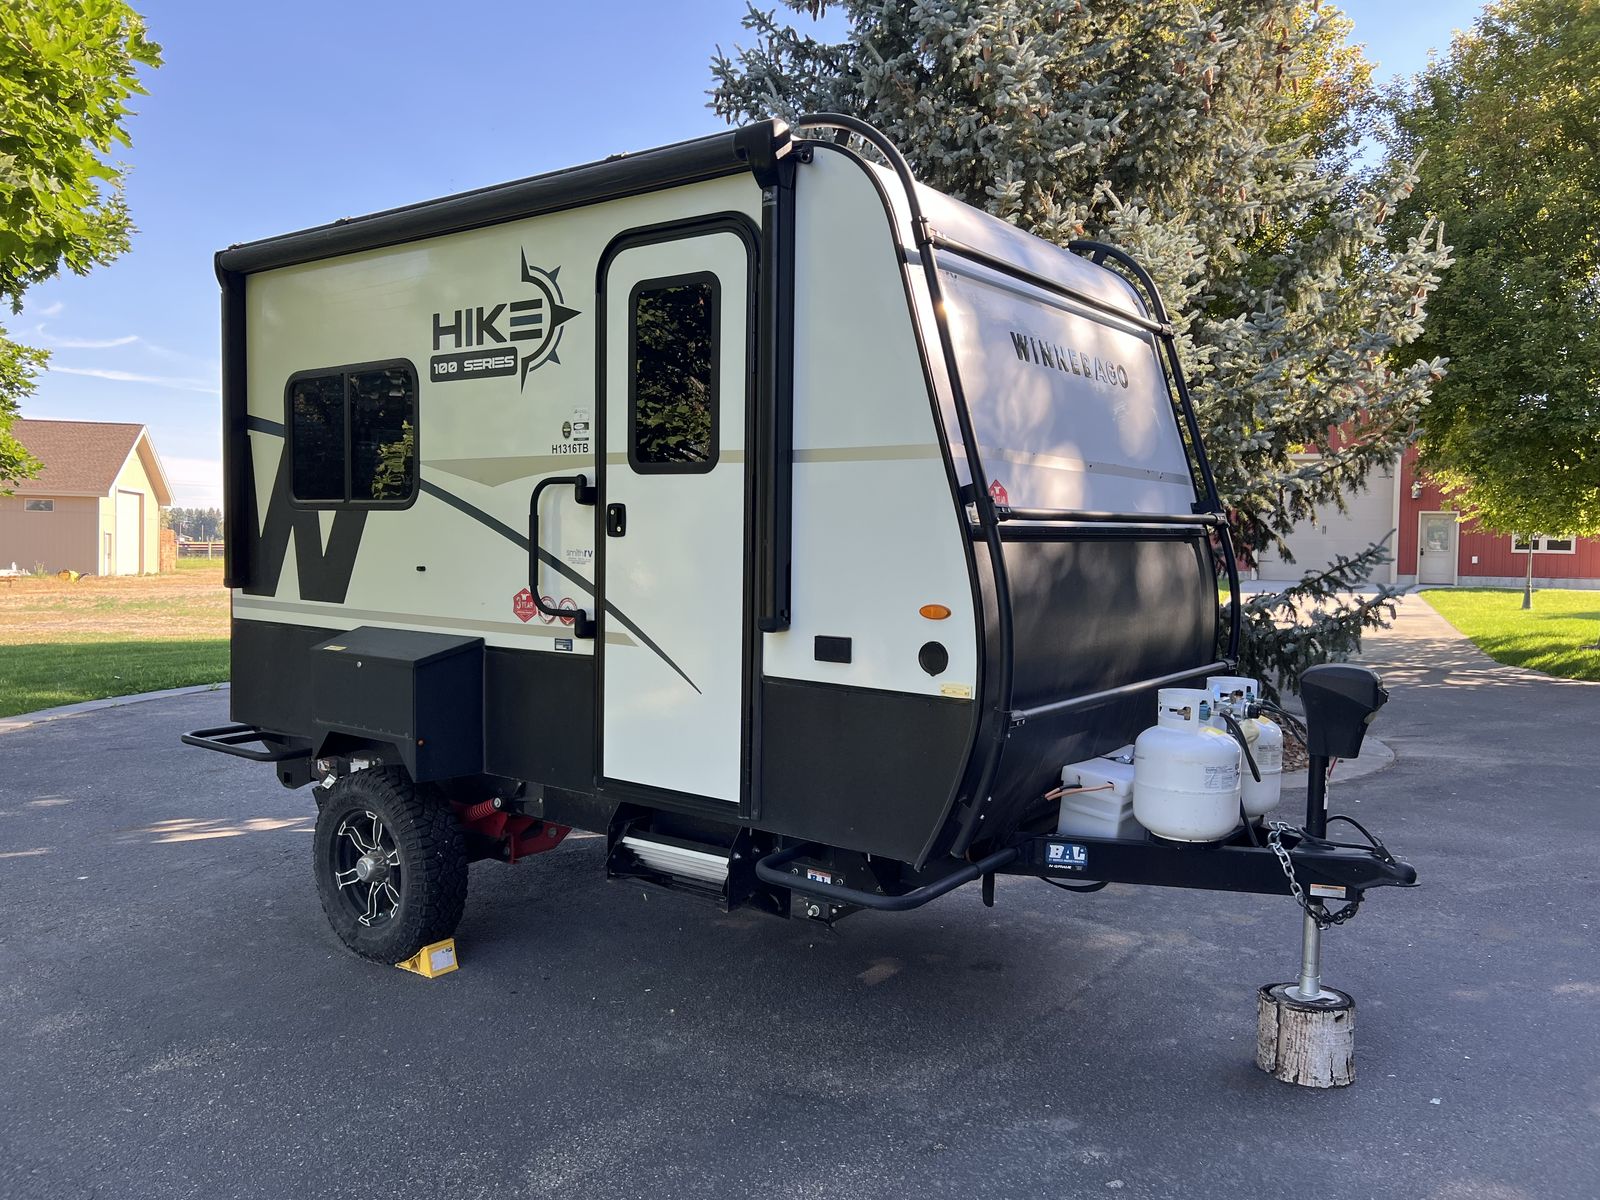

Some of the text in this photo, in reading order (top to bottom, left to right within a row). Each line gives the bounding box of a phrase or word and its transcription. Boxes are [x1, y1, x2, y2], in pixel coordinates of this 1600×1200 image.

[432, 298, 543, 350] HIKE
[433, 355, 515, 375] 100 SERIES
[1010, 331, 1129, 389] WINNEBAGO
[551, 443, 589, 454] H1316TB
